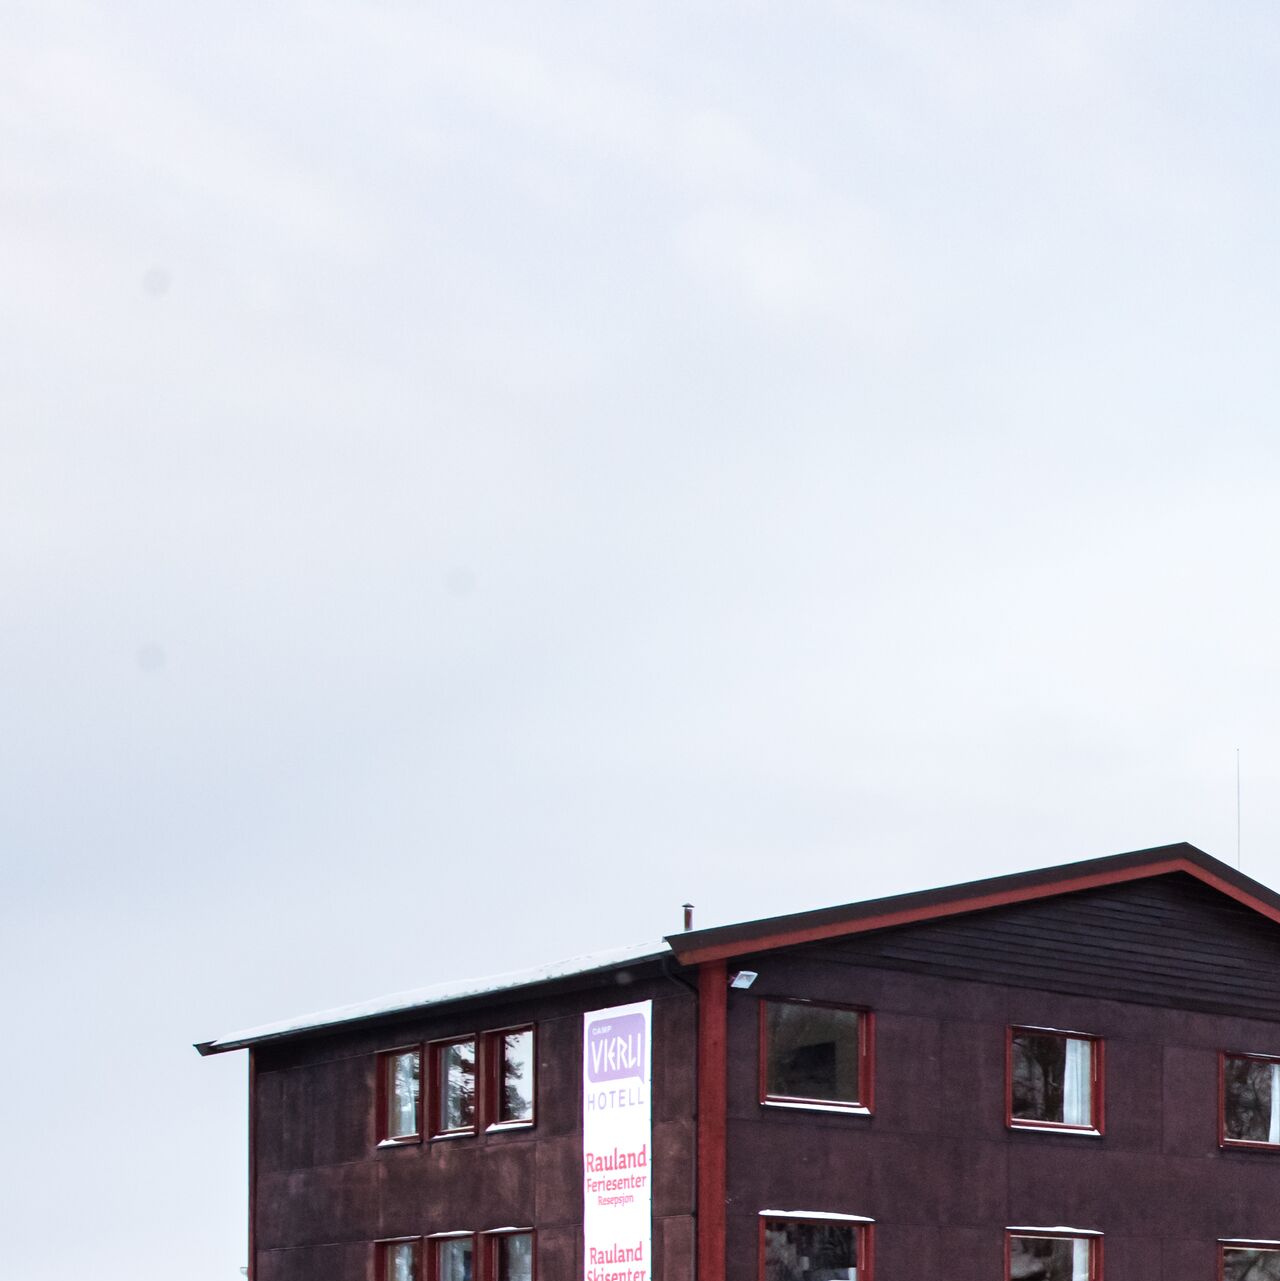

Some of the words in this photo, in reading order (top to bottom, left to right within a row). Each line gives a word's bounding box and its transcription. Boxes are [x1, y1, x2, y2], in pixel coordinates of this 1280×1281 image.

[592, 1025, 612, 1035] CAMP
[591, 1032, 642, 1074] VIERLI
[588, 1087, 645, 1112] HOTELL
[586, 1143, 647, 1173] Rauland
[586, 1174, 647, 1193] Feriesenter
[597, 1193, 634, 1207] Resepsjon
[589, 1240, 643, 1265] Rauland
